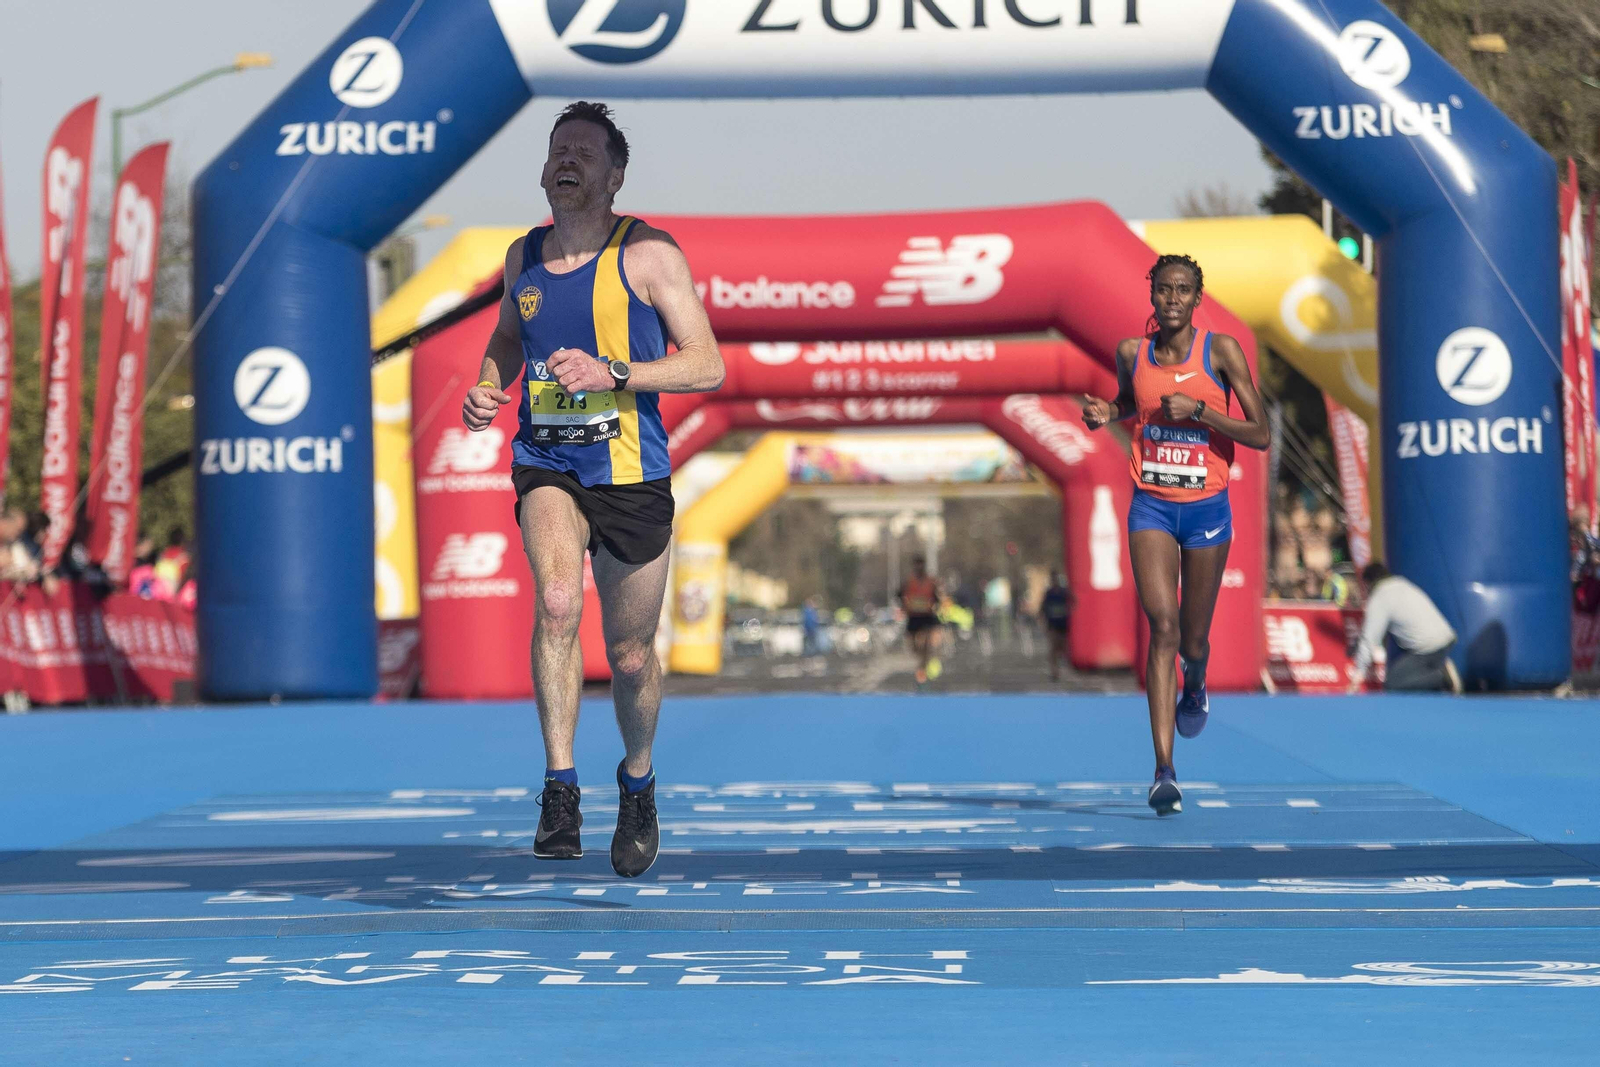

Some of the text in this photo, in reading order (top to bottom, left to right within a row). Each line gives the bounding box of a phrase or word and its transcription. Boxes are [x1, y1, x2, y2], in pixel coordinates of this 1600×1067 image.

[1293, 102, 1452, 140] ZURICH
[276, 121, 436, 156] ZURICH
[710, 275, 856, 308] balance
[102, 352, 138, 503] balance
[593, 430, 618, 442] ZURICH
[1162, 428, 1201, 443] ZURICH
[1397, 416, 1544, 459] ZURICH
[201, 436, 343, 474] ZURICH
[1157, 446, 1191, 464] F107
[31, 949, 974, 970] ZURICH
[0, 973, 985, 995] SEVILLA
